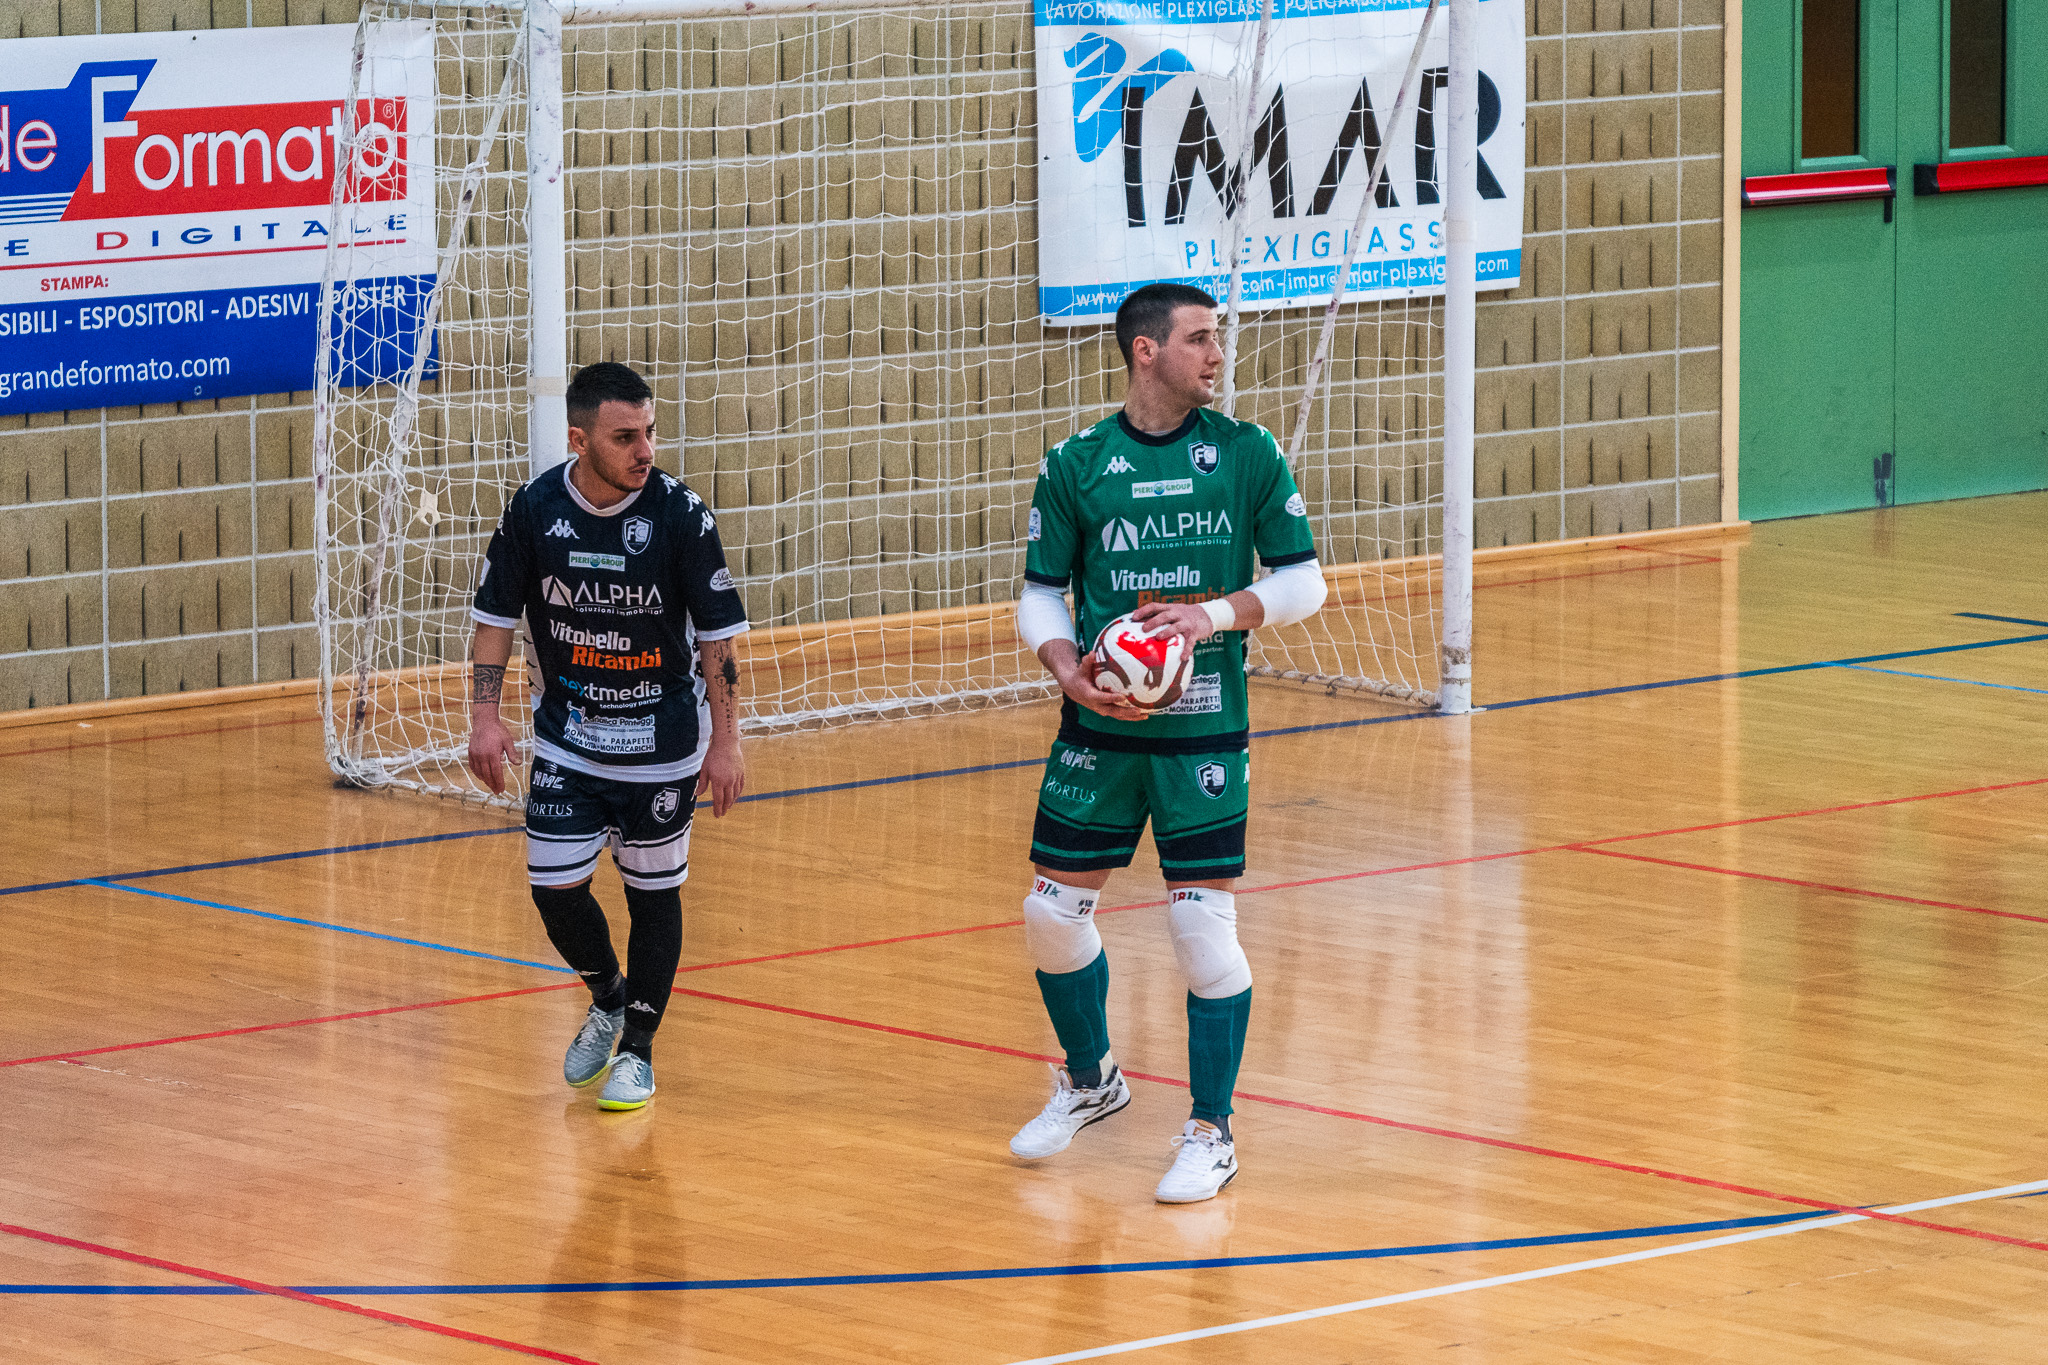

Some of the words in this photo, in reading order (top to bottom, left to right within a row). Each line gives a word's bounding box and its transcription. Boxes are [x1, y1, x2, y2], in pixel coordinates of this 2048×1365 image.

[1045, 1, 1162, 19] LAVORAZIONE
[91, 73, 398, 194] Formato
[1121, 66, 1507, 228] IMAR
[96, 213, 407, 251] DIGITALE
[1185, 220, 1442, 269] PLEXIGLASS
[40, 274, 109, 292] STAMPA:
[0, 309, 57, 336] SIBILI
[79, 298, 204, 332] ESPOSITORI
[225, 292, 310, 321] ADESIVI
[332, 284, 407, 311] POSTER
[0, 354, 230, 398] grandeformato.com
[1133, 486, 1153, 494] PIERI
[1165, 482, 1191, 492] GROUP
[1141, 509, 1233, 540] ALPHA
[1142, 541, 1183, 550] soluzioni
[570, 555, 590, 564] PIERI
[601, 557, 624, 567] GROUP
[1110, 565, 1201, 591] Vitobello
[573, 580, 662, 606] ALPHA
[575, 606, 615, 614] soluzioni
[549, 619, 632, 651] Vitobello
[571, 646, 662, 671] Ricambi
[600, 700, 637, 710] technology
[1169, 703, 1220, 713] MONTACARICHI
[1180, 695, 1220, 705] PARAPETTI
[600, 743, 655, 753] MONTACARICHI
[610, 736, 655, 746] PARAPETTI
[1045, 775, 1097, 804] HORTUS
